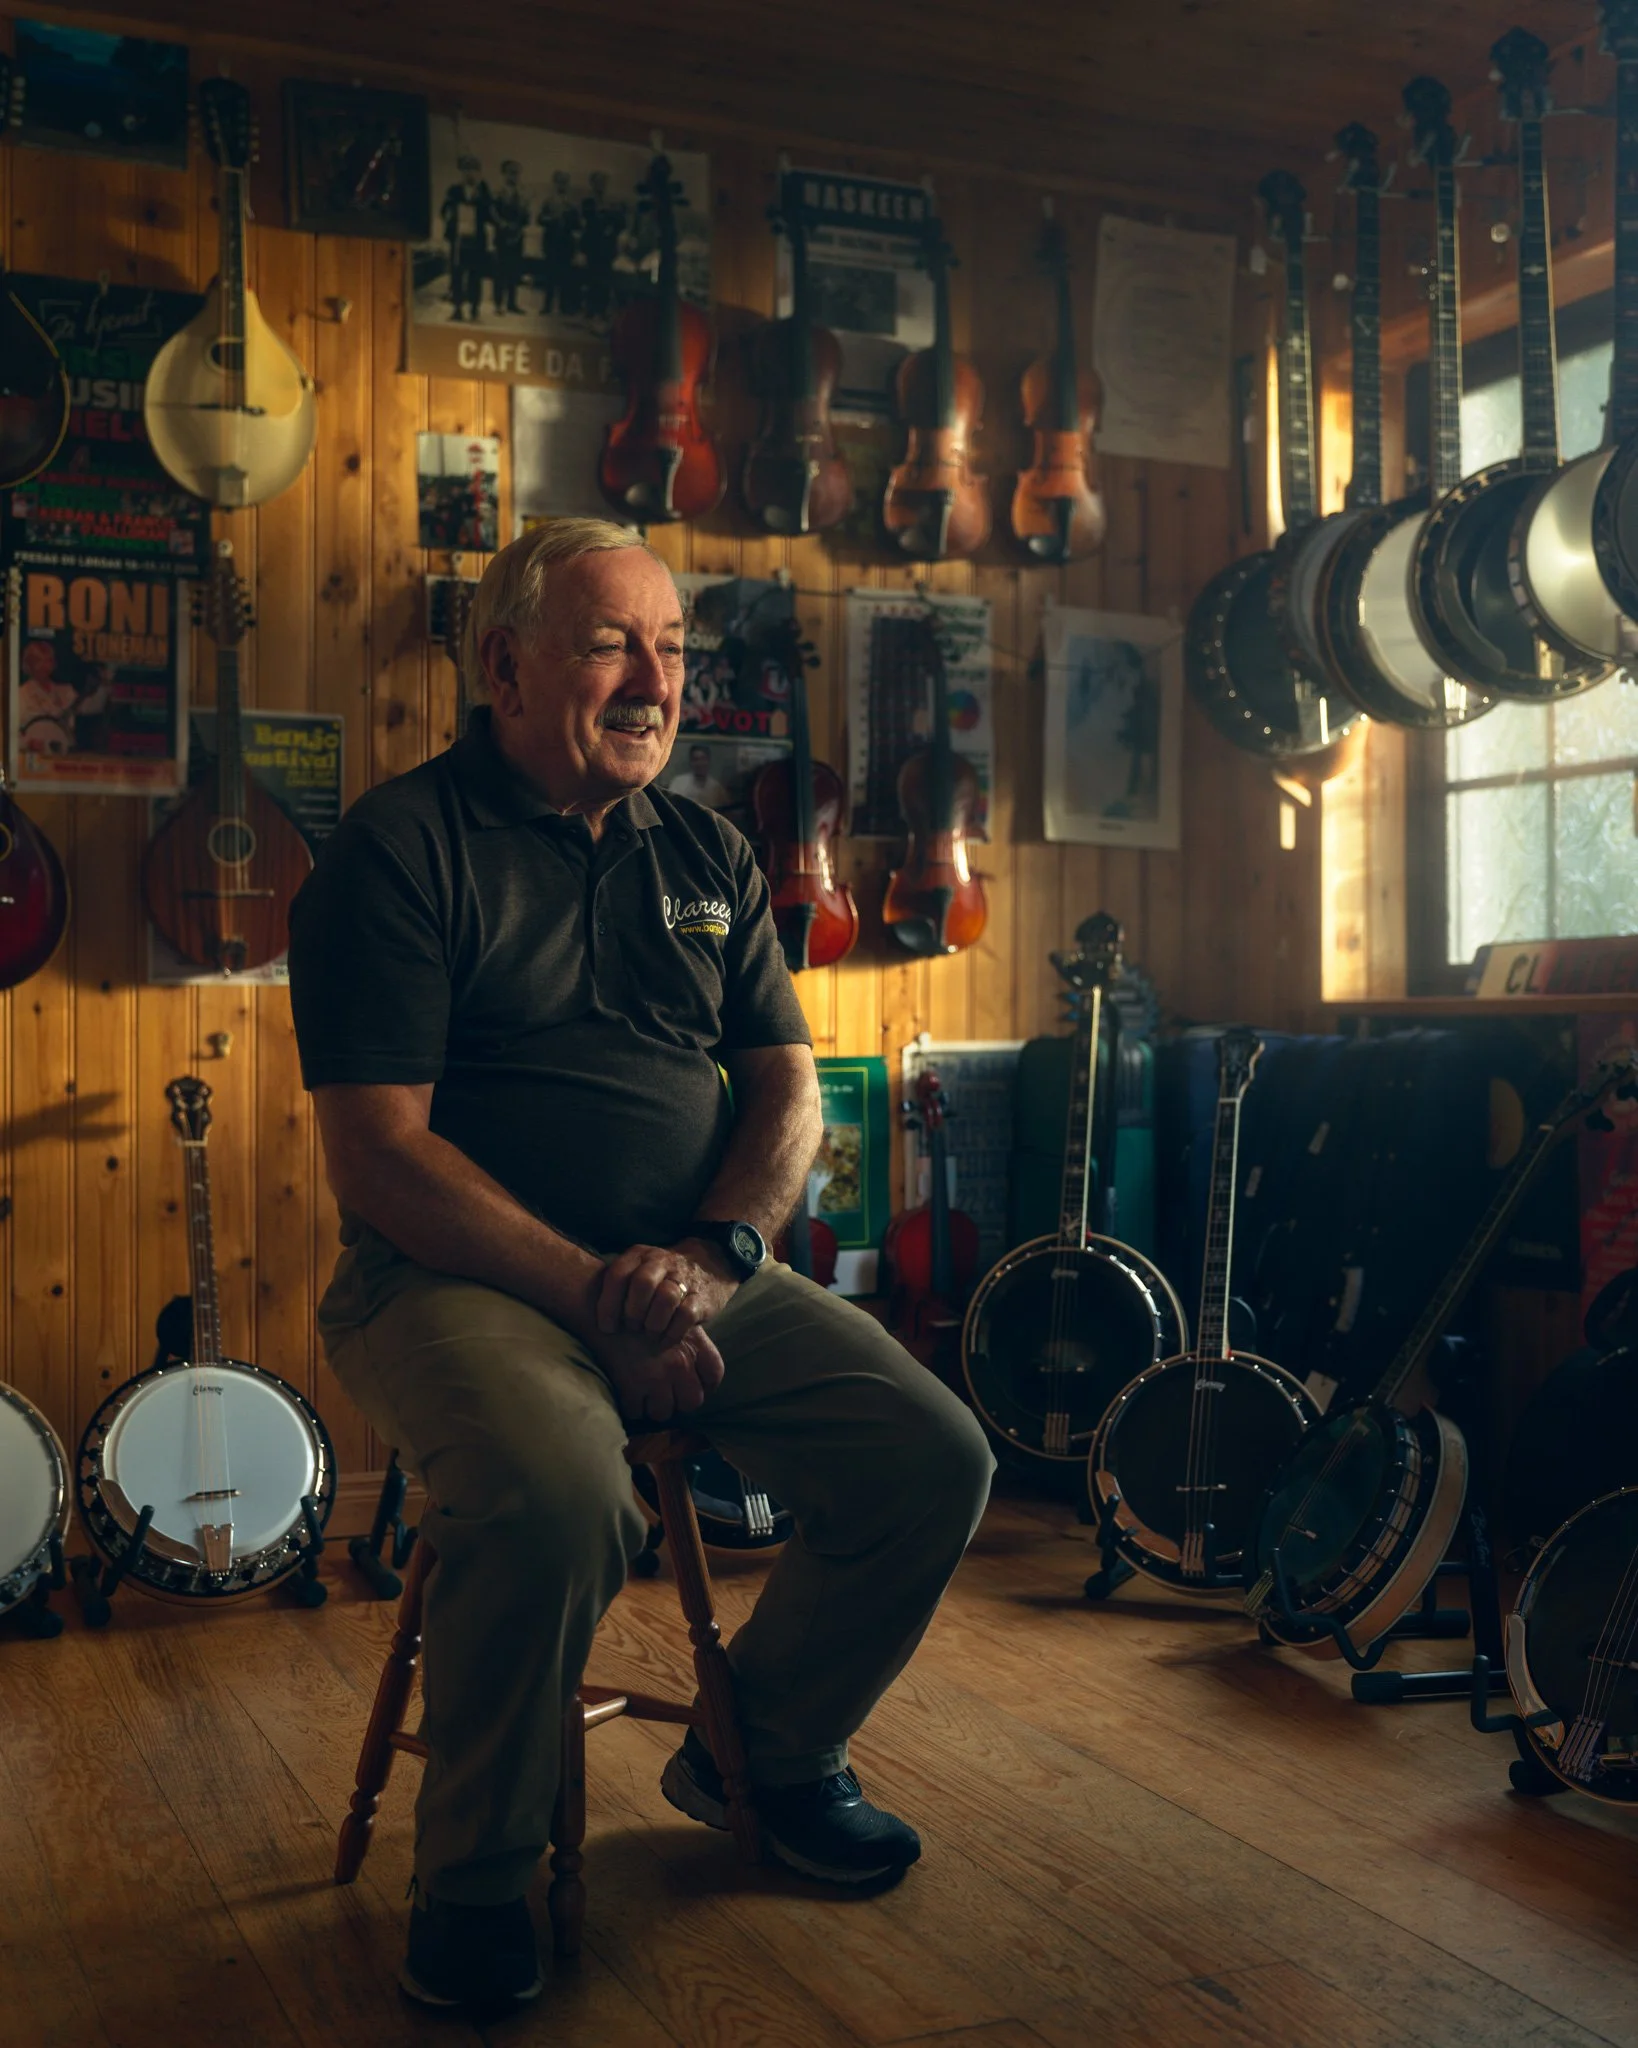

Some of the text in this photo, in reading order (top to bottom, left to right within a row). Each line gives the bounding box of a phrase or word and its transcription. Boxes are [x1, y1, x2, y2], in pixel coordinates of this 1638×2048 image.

[457, 338, 531, 375] CAFÉ
[545, 348, 585, 382] DA
[27, 572, 169, 636] RONI
[714, 710, 789, 734] VOT
[254, 723, 340, 751] Banjo
[244, 748, 337, 768] estival
